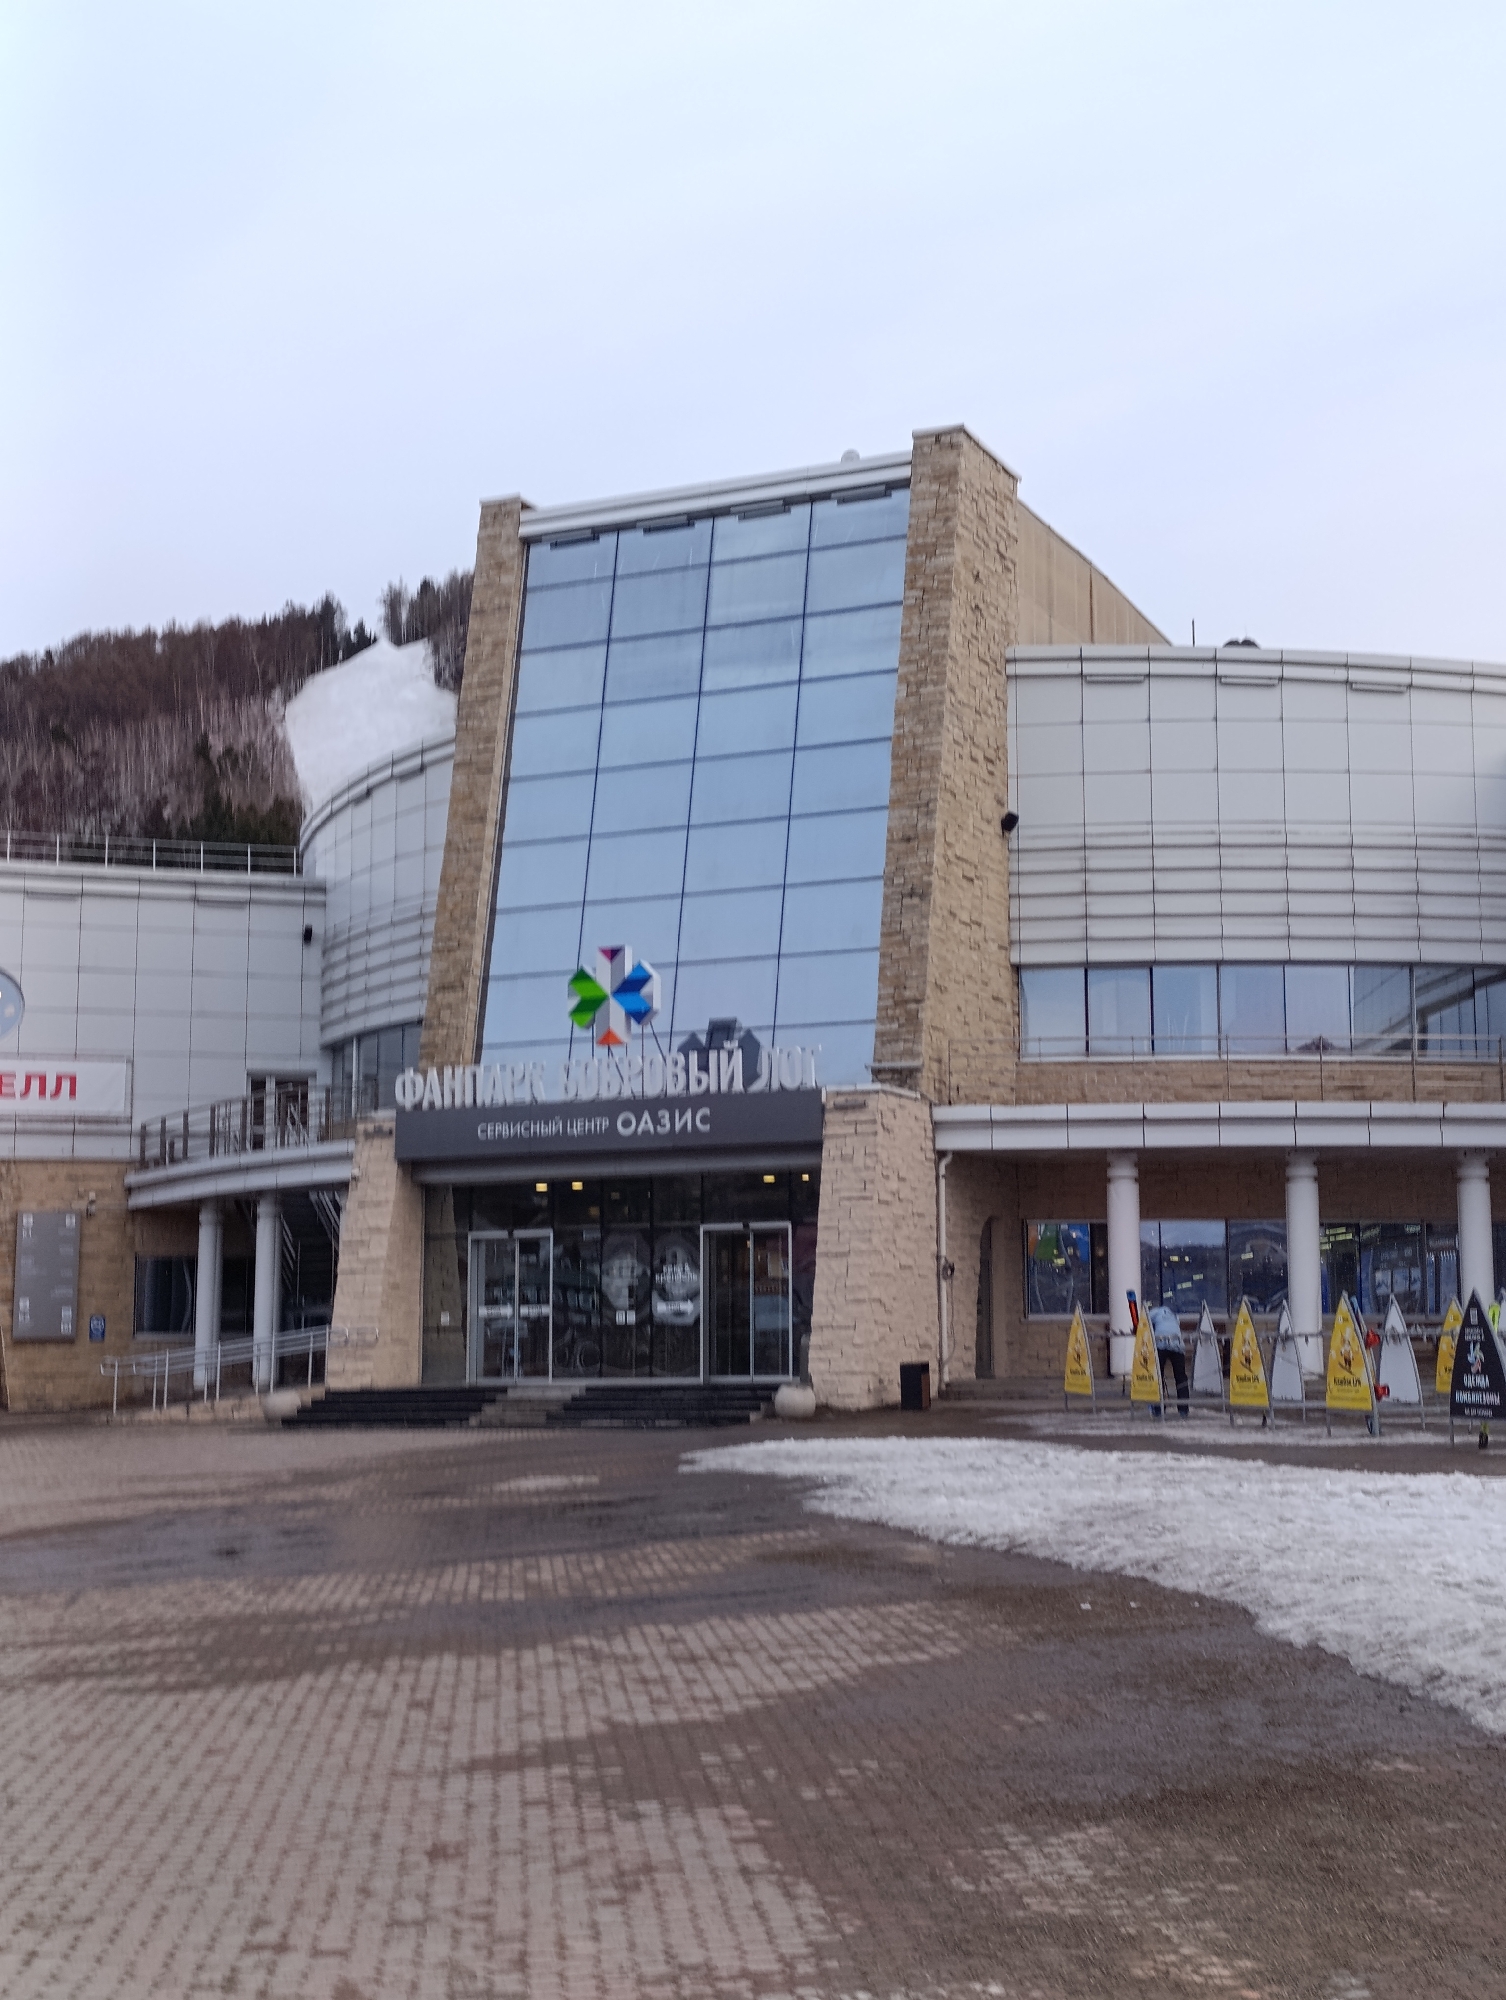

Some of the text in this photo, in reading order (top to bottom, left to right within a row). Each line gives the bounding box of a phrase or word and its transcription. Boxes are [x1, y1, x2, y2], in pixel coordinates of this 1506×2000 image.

[394, 1040, 822, 1112] ФАНПАРК БОБРОВЫЙ ЛОГ
[477, 1106, 711, 1141] СЕРВИСНЫЙ ЦЕНТР ОАЗИС
